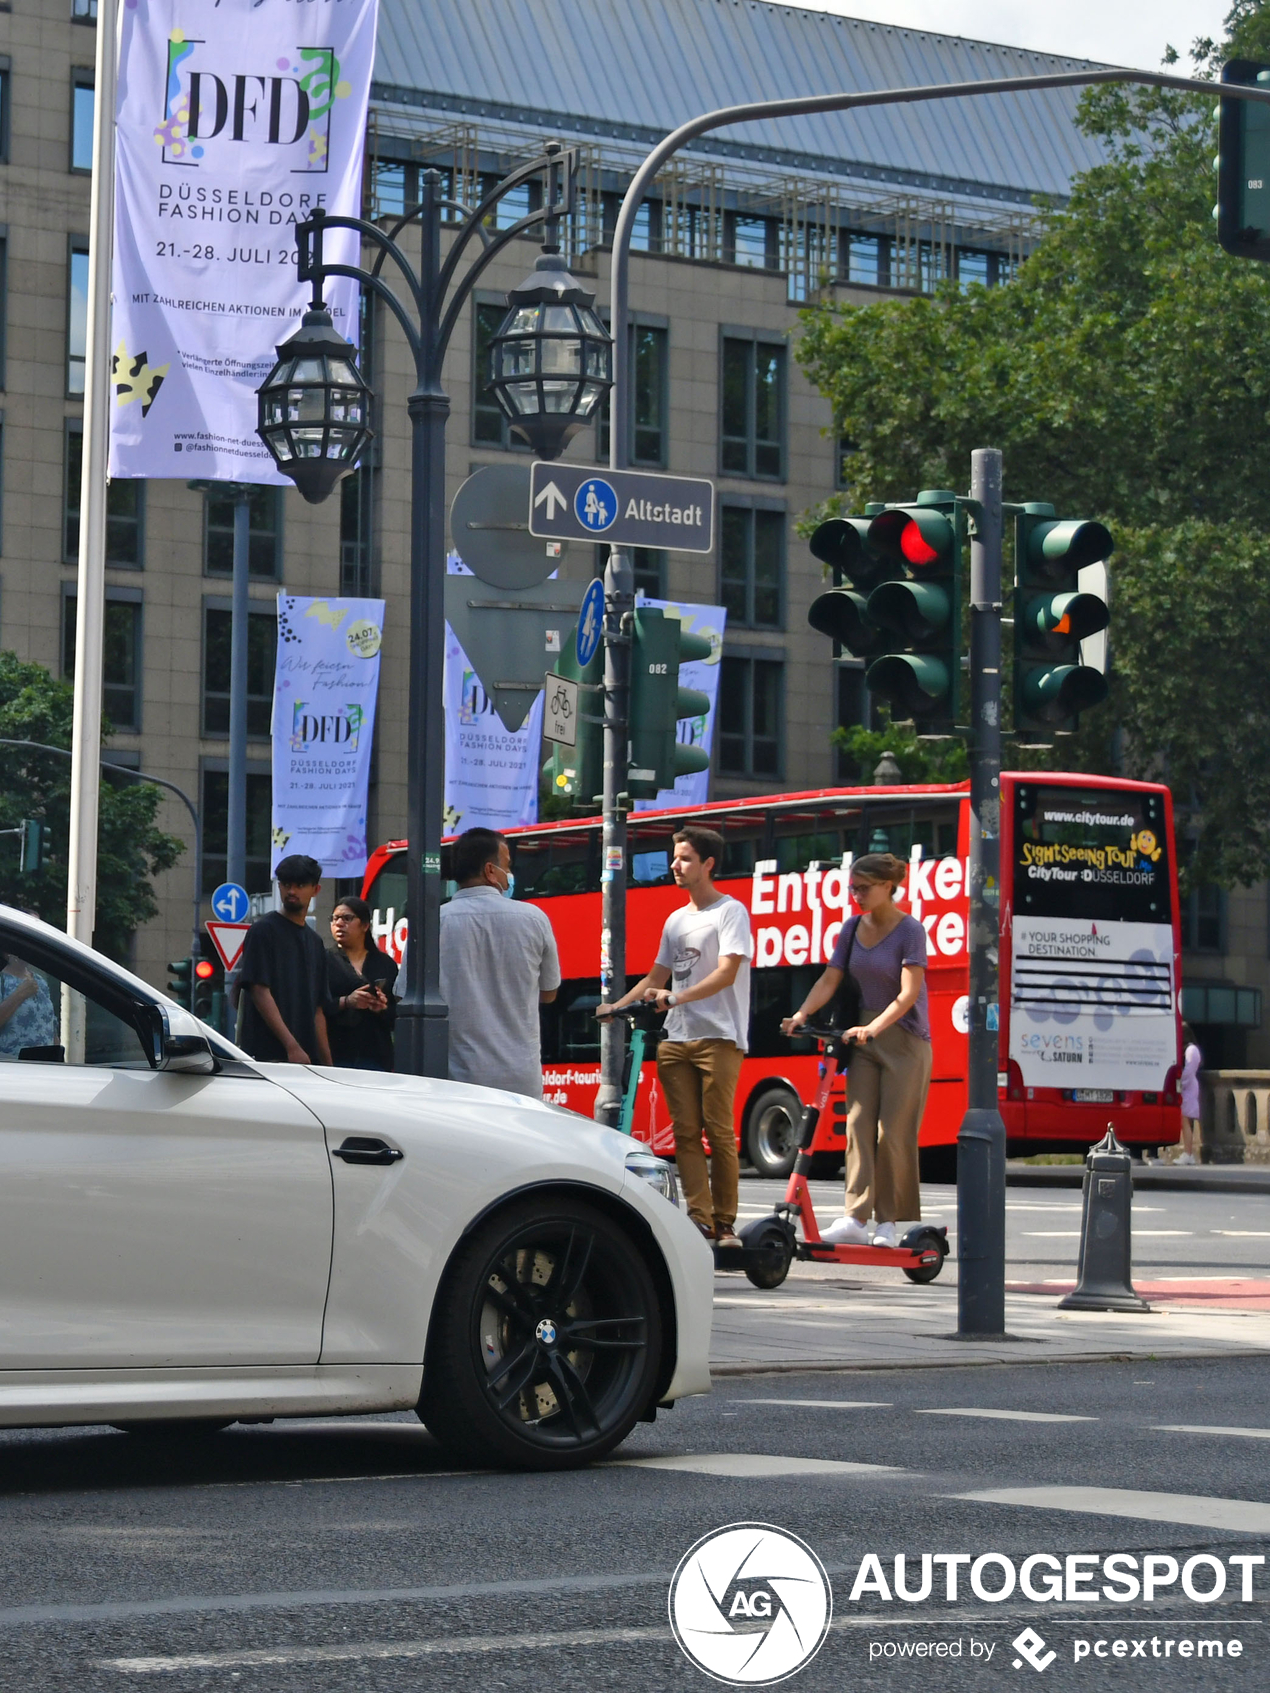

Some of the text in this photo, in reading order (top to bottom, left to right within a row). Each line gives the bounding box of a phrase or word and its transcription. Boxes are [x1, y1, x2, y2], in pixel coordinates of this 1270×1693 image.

[185, 71, 310, 145] DFD
[159, 182, 327, 209] DÜSSELDORF
[158, 203, 313, 226] FASHION DAY
[156, 241, 220, 261] 21.-28.
[227, 247, 271, 264] JULI
[132, 293, 150, 304] MIT
[153, 293, 225, 313] ZAHLREICHEN
[229, 304, 285, 318] AKTIONEN
[289, 308, 302, 317] IM
[182, 362, 203, 373] vielen
[625, 498, 702, 526] Altstadt
[649, 663, 668, 674] 082
[301, 715, 352, 743] DFD
[554, 720, 566, 736] frei
[460, 741, 528, 753] FASHION DAYS
[290, 759, 357, 768] DÜSSELDORF
[290, 766, 357, 775] FASHION DAYS
[318, 782, 337, 790] JULI
[1043, 811, 1134, 827] www.citytour.de
[1028, 865, 1078, 881] CityTour
[1029, 931, 1057, 943] YOUR
[1060, 932, 1110, 946] SHOPPING
[1021, 1033, 1084, 1051] sevens
[1052, 1051, 1084, 1064] SATURN
